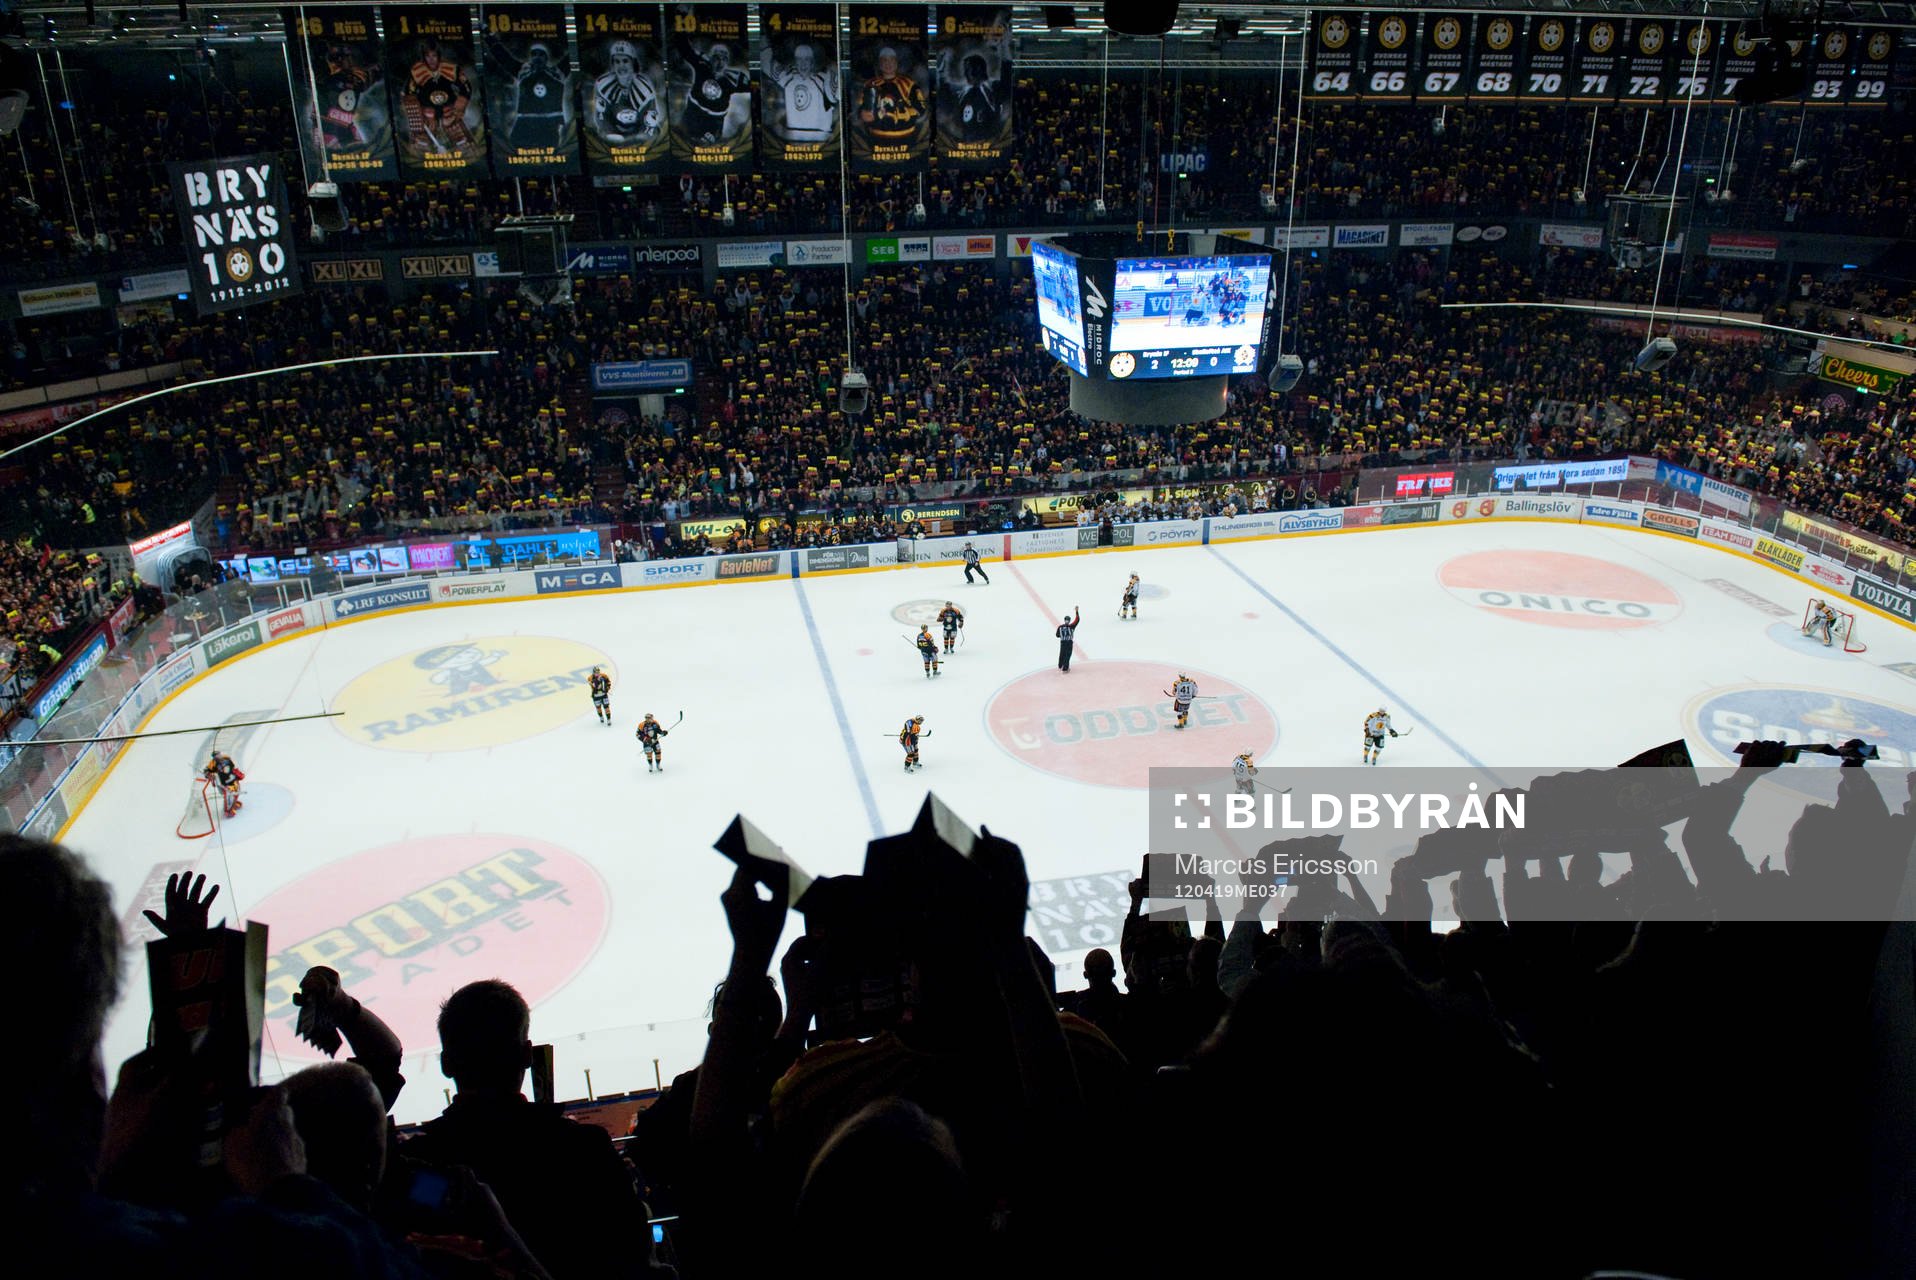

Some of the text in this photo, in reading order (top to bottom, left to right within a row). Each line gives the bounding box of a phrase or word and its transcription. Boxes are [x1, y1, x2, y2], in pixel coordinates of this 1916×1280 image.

[400, 16, 411, 34] 1
[586, 13, 609, 32] 14
[675, 15, 697, 33] 10
[769, 13, 782, 32] 4
[859, 16, 879, 34] 12
[1313, 71, 1350, 92] 64
[1370, 71, 1407, 92] 66
[1424, 72, 1460, 93] 67
[1476, 73, 1513, 92] 68
[1528, 74, 1562, 93] 70
[1580, 75, 1608, 93] 71
[1628, 77, 1660, 95] 72
[1676, 77, 1708, 95] 76
[1811, 80, 1843, 98] 93
[1855, 81, 1886, 98] 99
[1161, 152, 1206, 172] LIPAC
[184, 164, 271, 207] BRY
[193, 204, 280, 248] NÄS
[636, 246, 700, 264] interpool
[872, 245, 896, 256] SEB
[210, 277, 290, 303] 1912-2012
[1095, 323, 1104, 366] MIDROC
[1152, 359, 1159, 370] 2
[1210, 356, 1218, 367] 0
[1825, 358, 1880, 388] Cheers
[1581, 467, 1605, 477] sedan
[1664, 466, 1697, 489] YIT
[1704, 479, 1750, 503] HUURRE
[917, 508, 960, 519] BERENDSEN
[1505, 500, 1573, 514] Ballingslöv
[1650, 512, 1693, 528] GROLLS
[1159, 529, 1198, 540] PÖYRY
[645, 563, 705, 576] SPORT
[354, 588, 429, 611] LRF KONSULT
[452, 583, 507, 597] POWERPLAY
[1855, 580, 1913, 618] VOLVIA
[1479, 590, 1652, 619] ONICO
[270, 612, 304, 632] GEVALIA
[208, 627, 257, 659] Läkerol
[1179, 685, 1191, 696] 41
